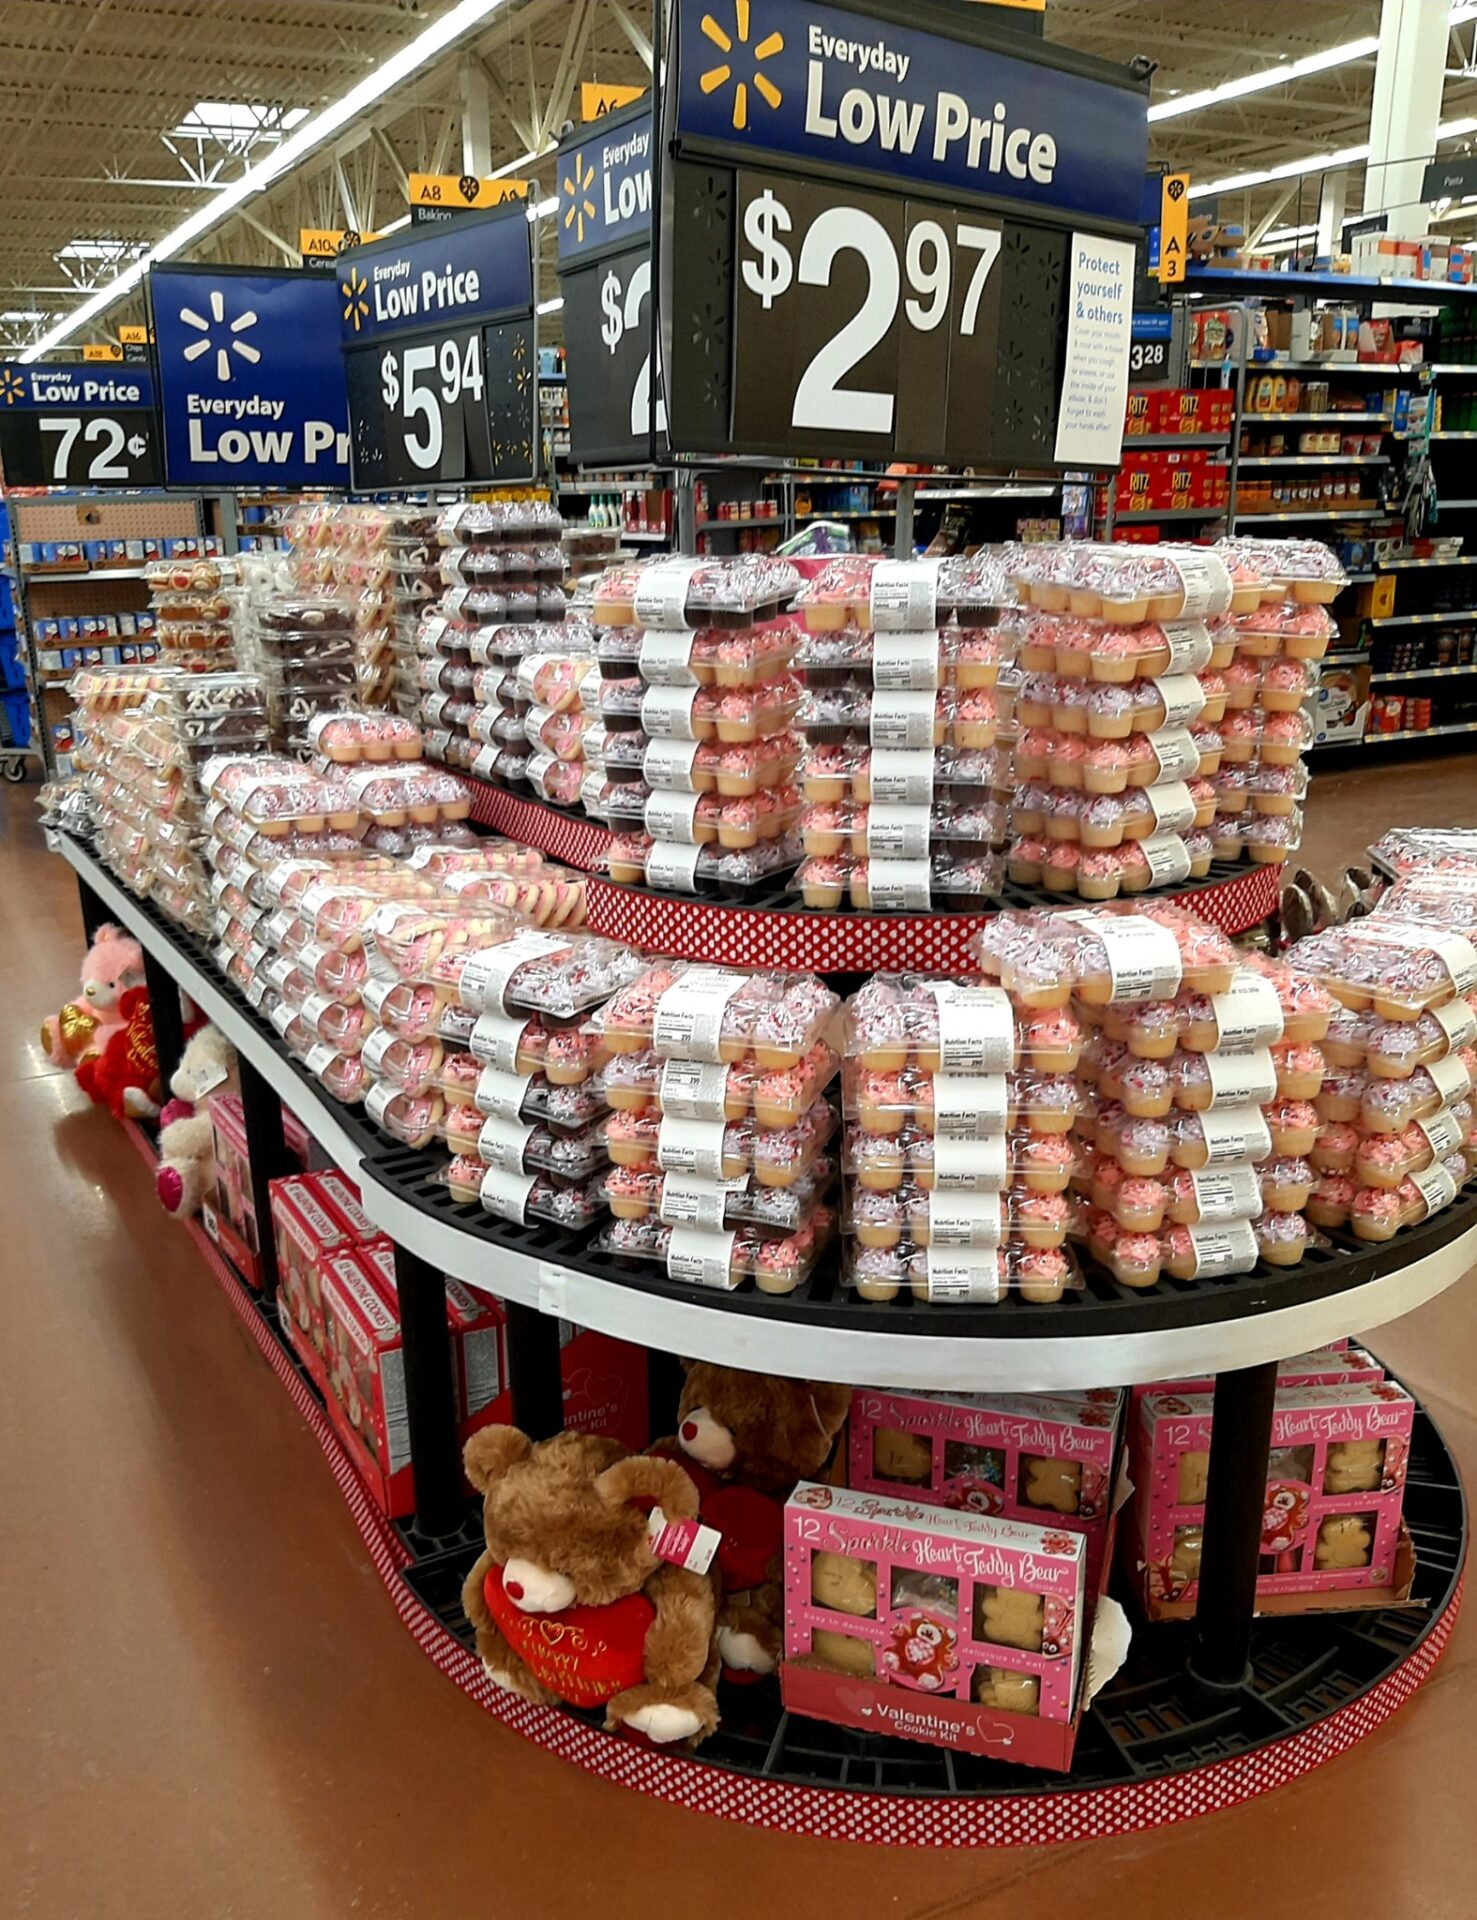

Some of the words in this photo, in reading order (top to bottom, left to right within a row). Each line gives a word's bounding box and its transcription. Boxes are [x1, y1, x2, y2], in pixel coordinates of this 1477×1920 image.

[808, 25, 910, 81] Everyday
[804, 60, 926, 156] Low
[932, 91, 1058, 184] Price
[603, 132, 650, 169] Everyday
[420, 184, 442, 201] A8
[308, 238, 331, 252] A10
[1164, 236, 1181, 256] A
[372, 261, 411, 281] Everyday
[1078, 252, 1121, 276] Protect
[1166, 261, 1177, 277] 3
[374, 279, 418, 322] Low
[421, 264, 480, 309] Price
[1076, 281, 1123, 300] yourself
[1075, 302, 1085, 319] &
[1088, 307, 1123, 325] others
[30, 371, 72, 384] Everyday
[32, 382, 80, 402] Low
[84, 382, 140, 402] Price
[187, 394, 285, 420] Everyday
[1128, 396, 1149, 414] RITZ
[1180, 395, 1199, 414] RITZ
[39, 417, 148, 479] 72¢
[187, 420, 293, 465] Low
[1130, 472, 1150, 491] RITZ
[1171, 471, 1192, 490] RITZ
[859, 1399, 883, 1420] 12
[963, 1414, 1010, 1439] Heart
[1009, 1423, 1057, 1456] Teddy
[1058, 1426, 1105, 1452] Bear
[1163, 1424, 1190, 1445] 12
[1275, 1412, 1319, 1441] Heart
[1320, 1409, 1363, 1440] Teddy
[1365, 1405, 1408, 1431] Bear
[792, 1515, 821, 1541] 12
[822, 1521, 913, 1556] Sparkle
[911, 1537, 963, 1565] Heart
[963, 1549, 1016, 1588] Teddy
[1018, 1553, 1070, 1583] Bear
[876, 1703, 976, 1737] Valentine's
[894, 1720, 937, 1739] Cookie
[939, 1728, 958, 1743] Kit
